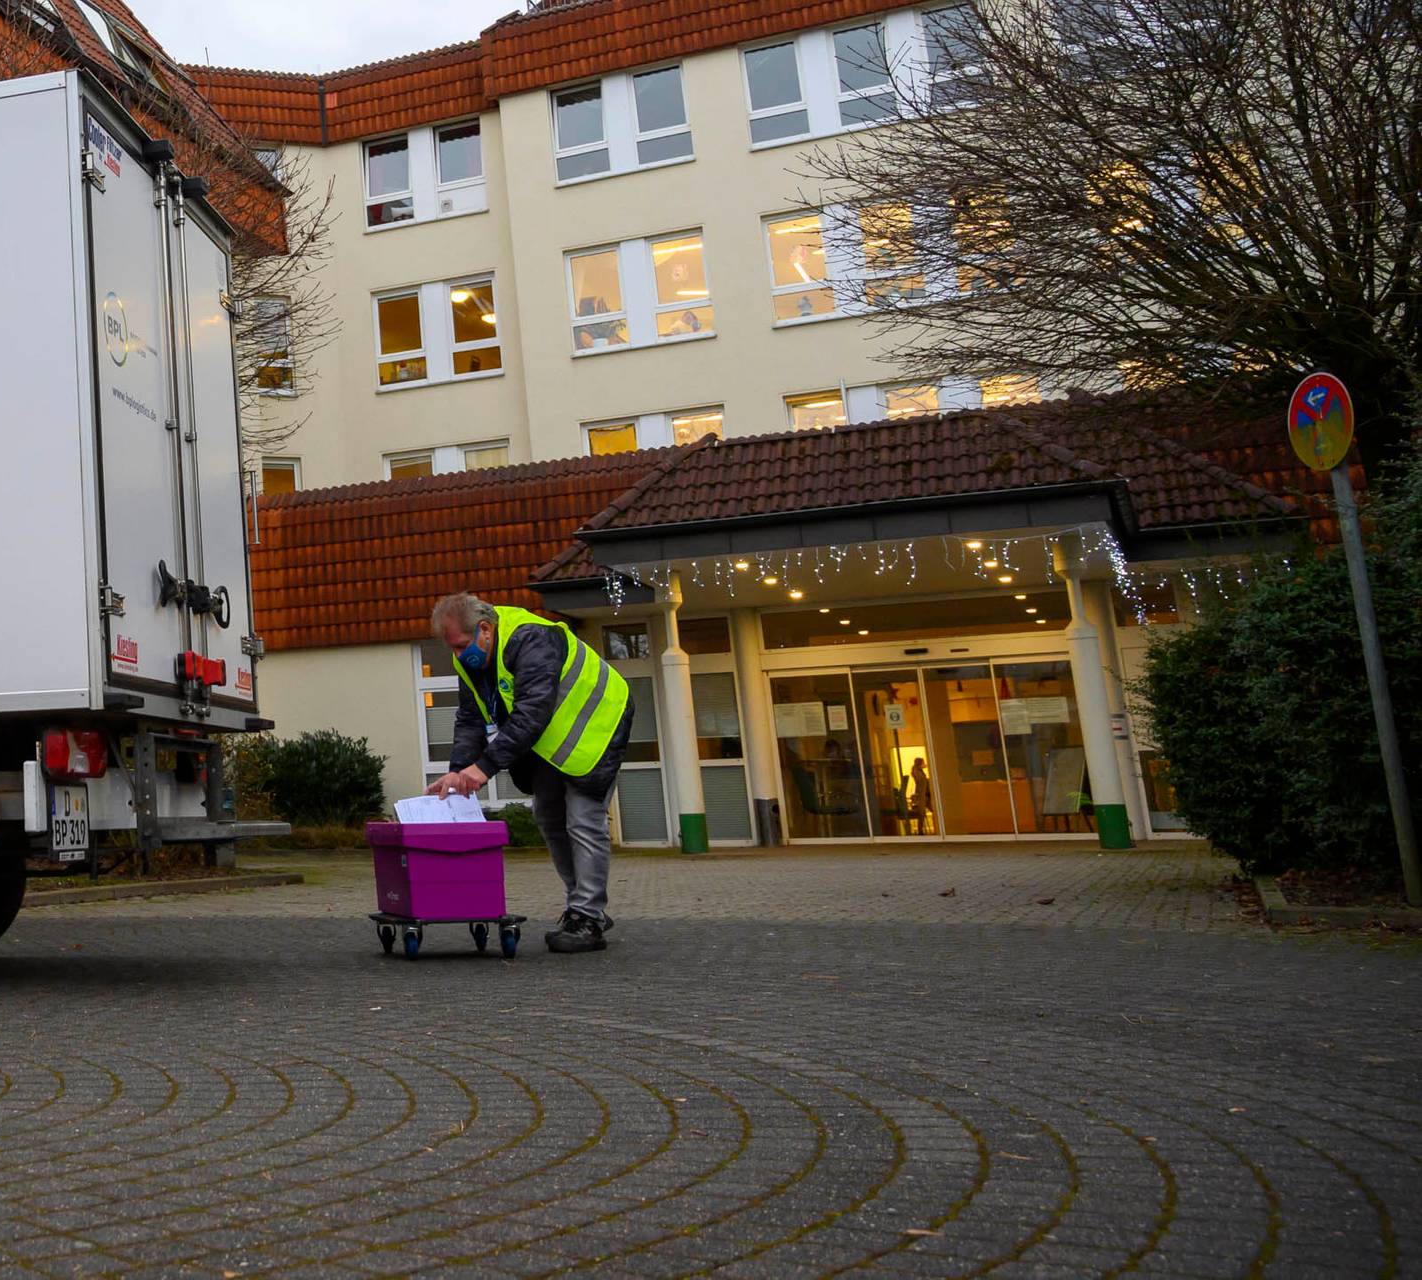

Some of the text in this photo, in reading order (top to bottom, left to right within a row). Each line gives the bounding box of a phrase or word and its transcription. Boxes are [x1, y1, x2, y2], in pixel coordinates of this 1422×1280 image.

[107, 315, 124, 343] BPL
[64, 790, 70, 817] D
[54, 819, 85, 846] BP 319
